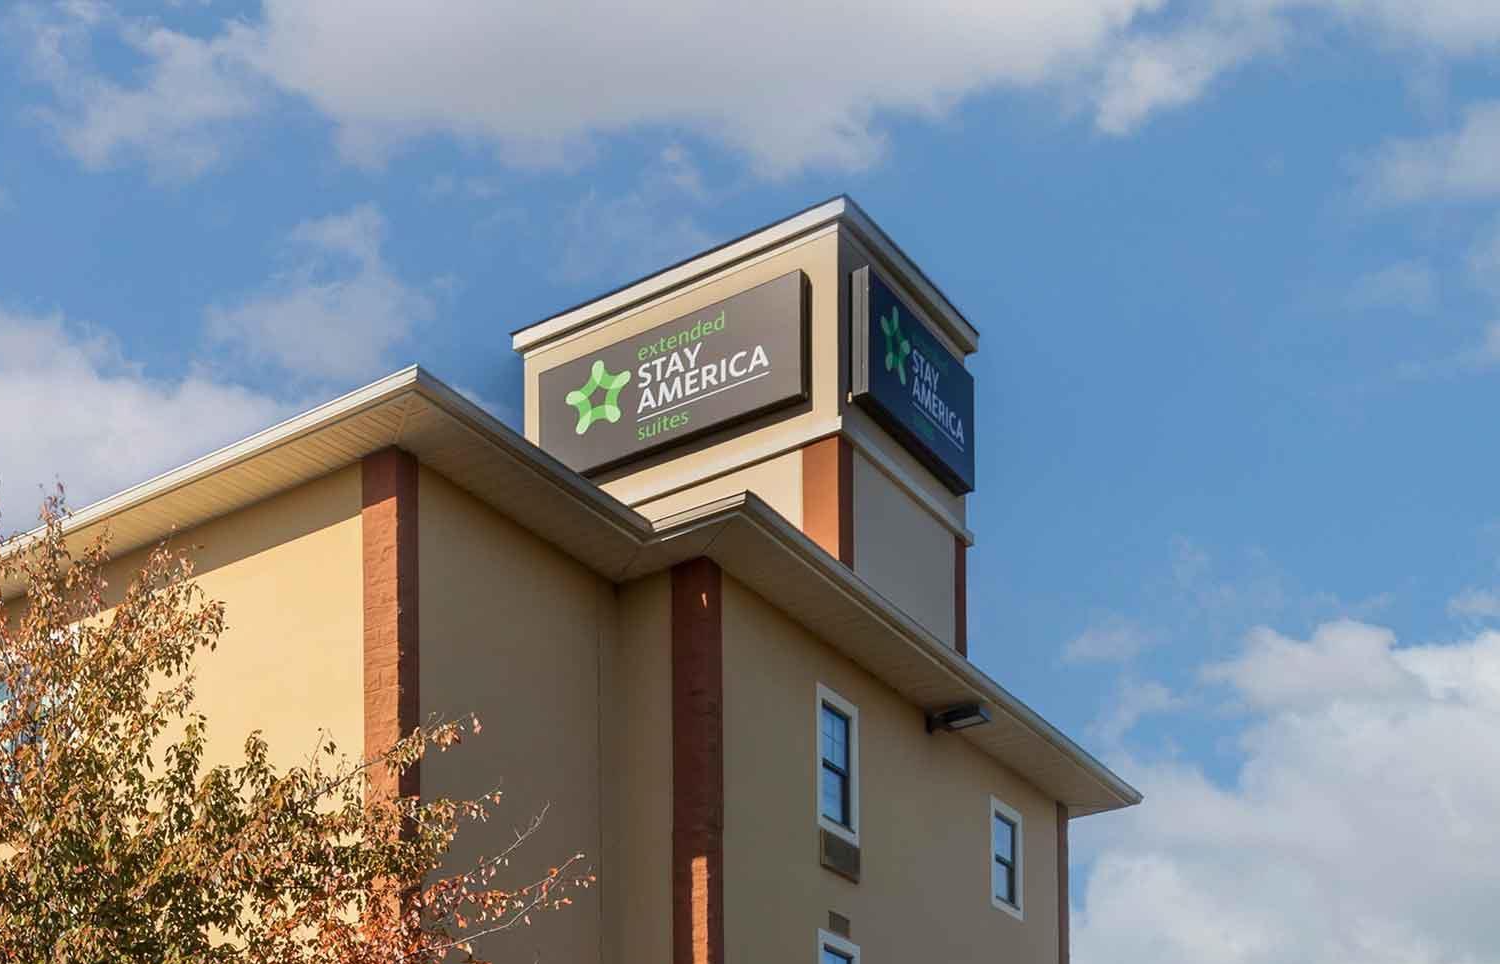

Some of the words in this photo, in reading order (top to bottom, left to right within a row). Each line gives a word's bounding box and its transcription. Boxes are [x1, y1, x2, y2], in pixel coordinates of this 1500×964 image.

[637, 311, 726, 361] extended
[637, 343, 703, 389] STAY
[637, 345, 771, 414] AMERICA
[912, 349, 940, 393] STAY
[637, 410, 690, 441] suites
[912, 375, 965, 445] AMERICA
